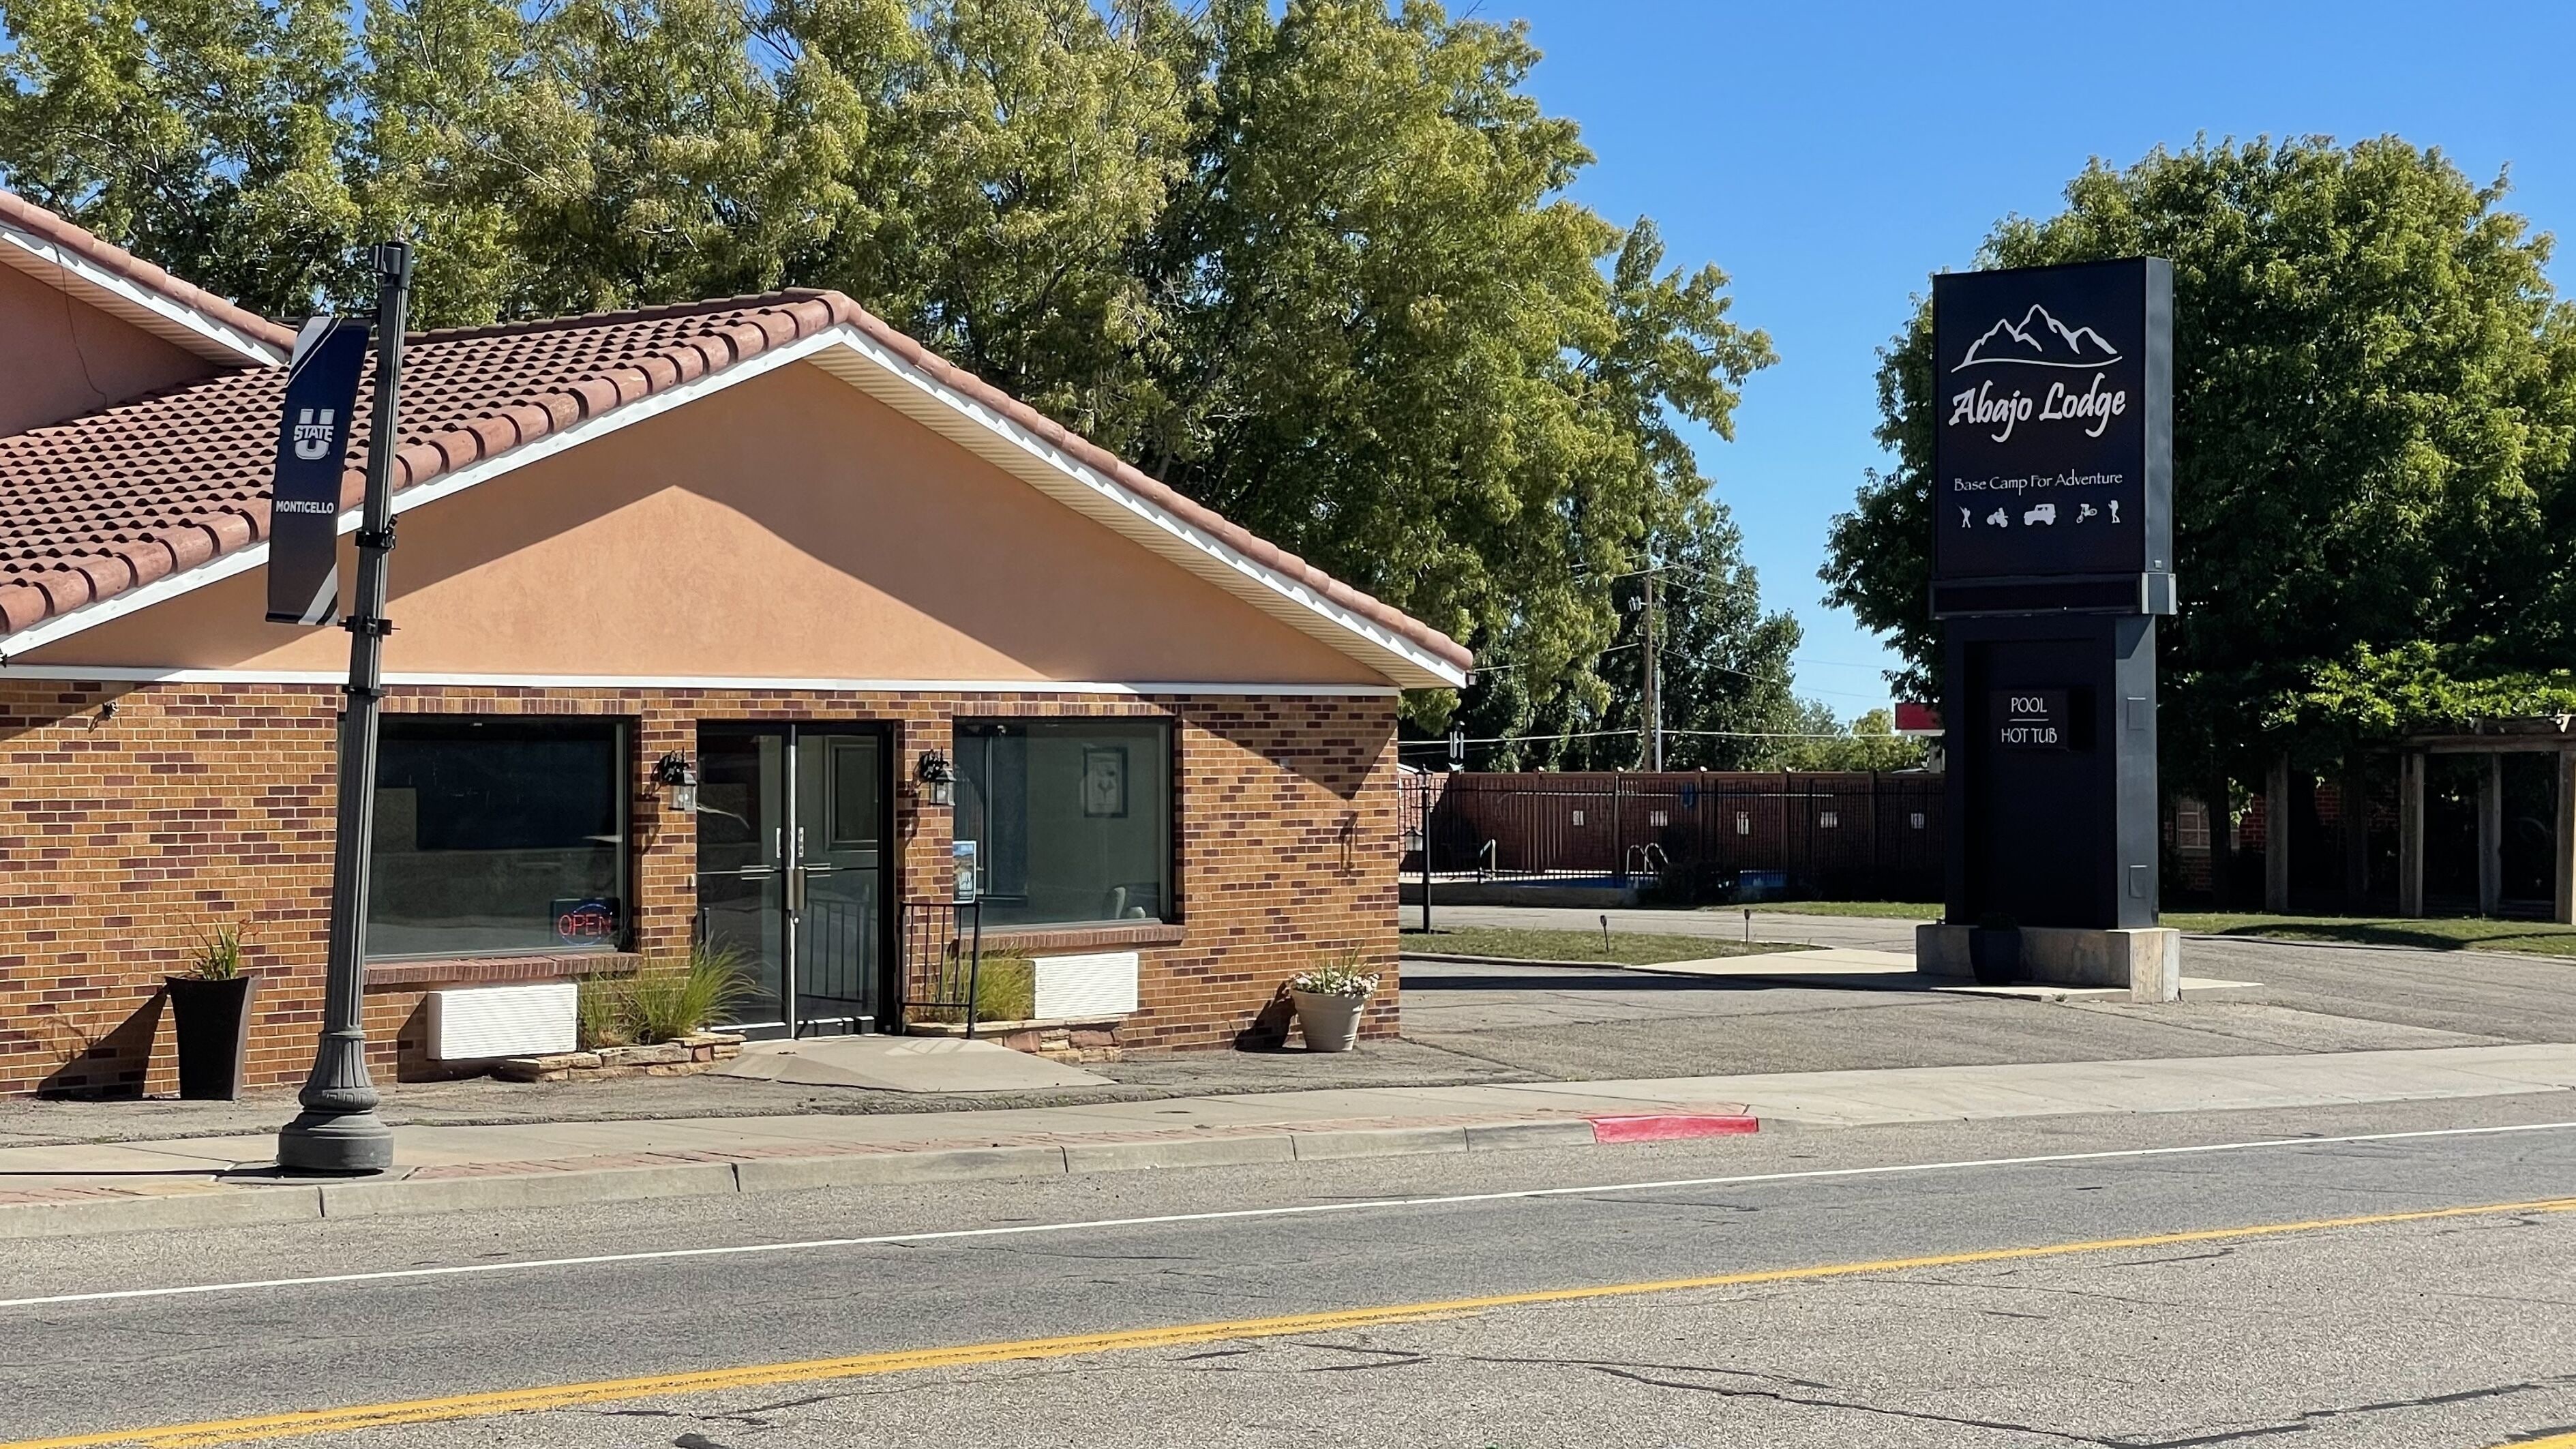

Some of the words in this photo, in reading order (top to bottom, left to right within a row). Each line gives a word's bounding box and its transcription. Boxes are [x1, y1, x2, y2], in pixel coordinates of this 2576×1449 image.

[1948, 379, 2033, 443] Abajo
[2039, 372, 2126, 438] Lodge
[293, 425, 334, 443] STATE
[295, 408, 335, 460] U
[1954, 478, 1987, 492] Base
[1989, 476, 2027, 496] Camp
[2031, 475, 2053, 488] For
[2055, 468, 2123, 486] Adventure
[275, 501, 334, 514] MONTICELLO
[2011, 697, 2048, 713] POOL
[2001, 728, 2029, 743] HOT
[2031, 727, 2058, 743] TUB
[558, 914, 612, 936] OPEN
